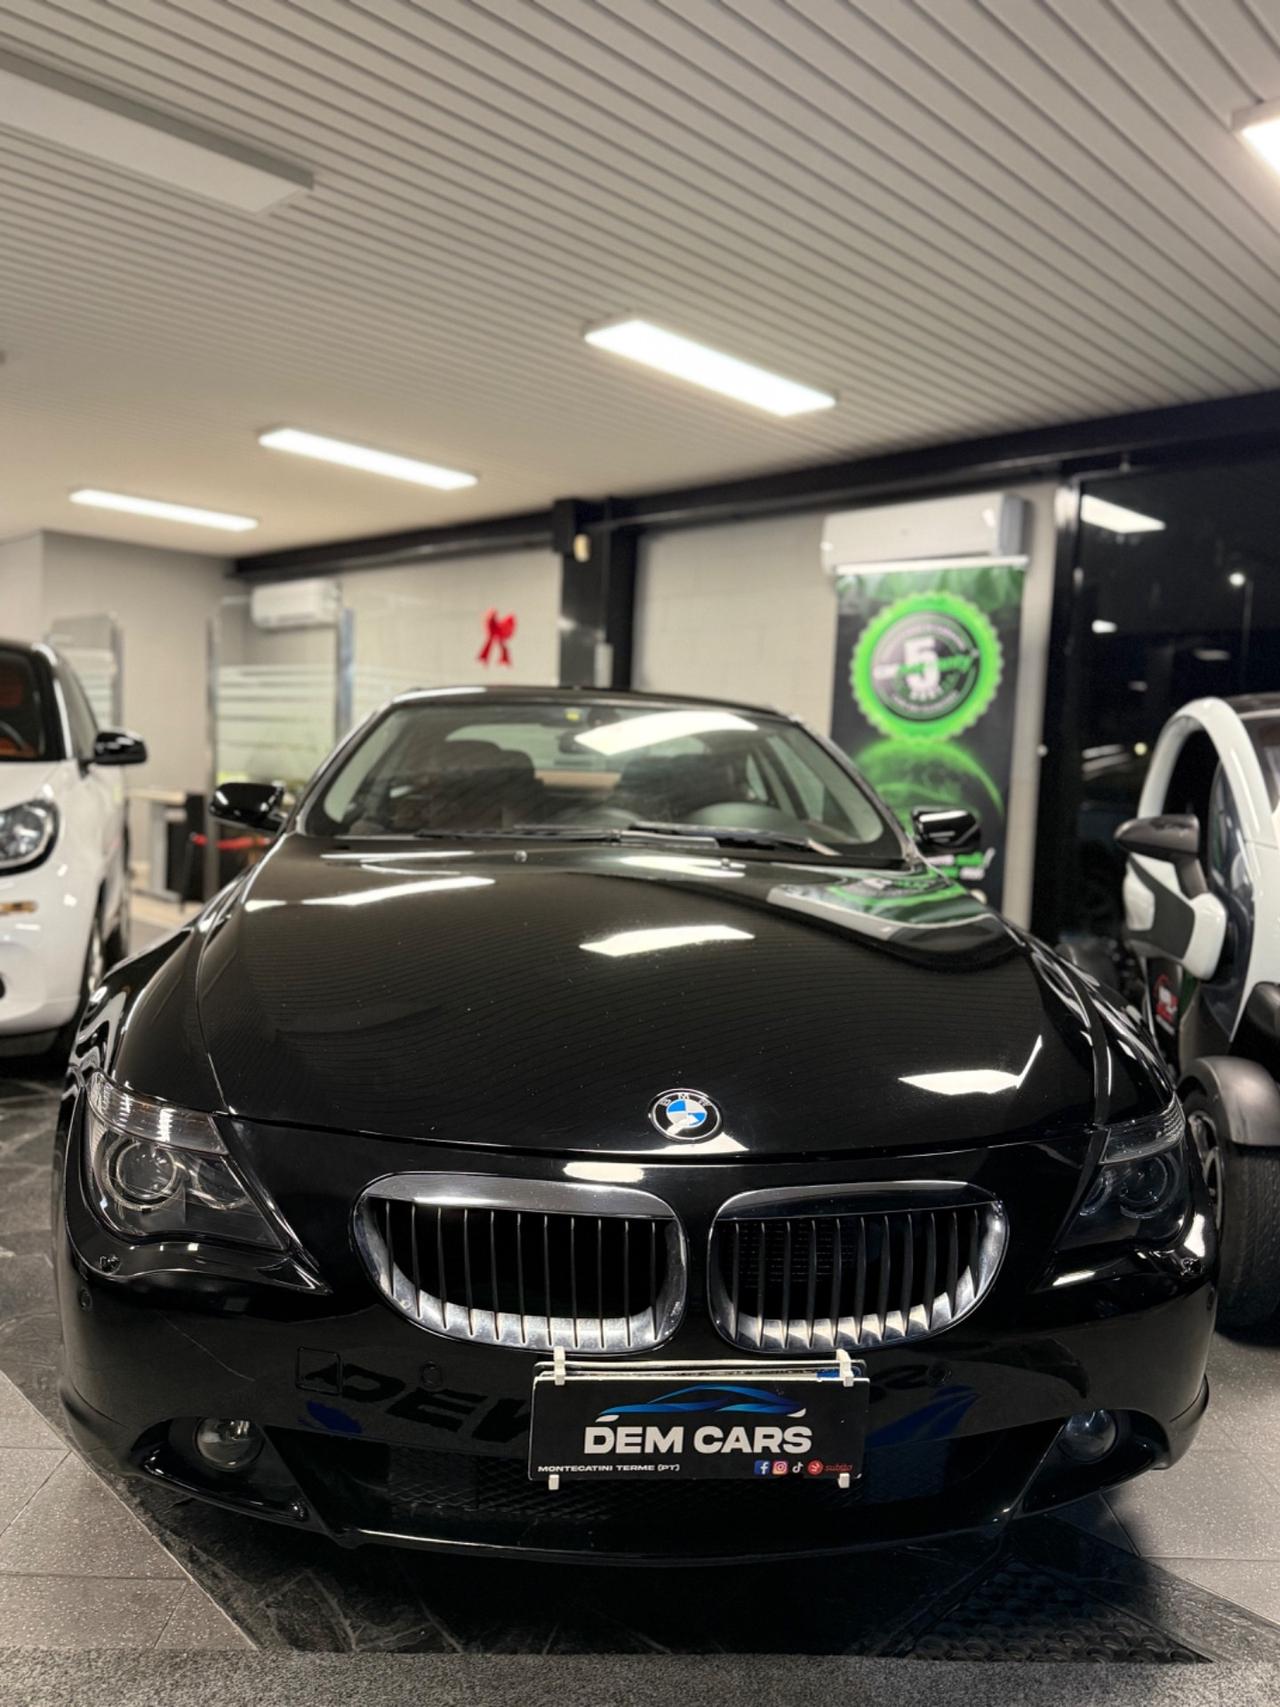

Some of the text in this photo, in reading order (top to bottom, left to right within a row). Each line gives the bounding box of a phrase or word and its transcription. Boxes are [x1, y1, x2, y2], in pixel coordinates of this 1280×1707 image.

[584, 1425, 812, 1454] DEM CARS
[537, 1463, 680, 1473] MONTECATINI TERME (PT)
